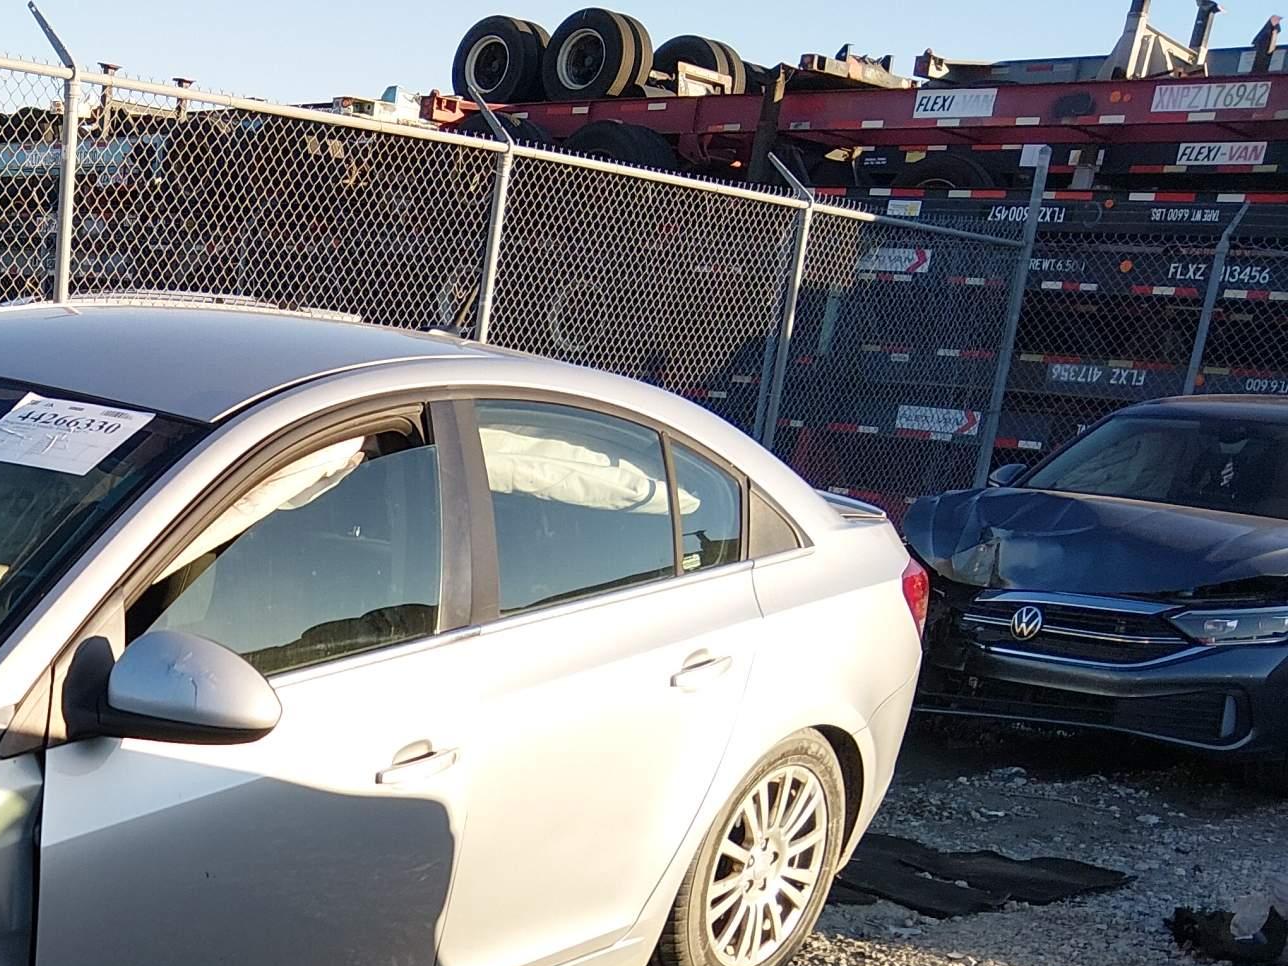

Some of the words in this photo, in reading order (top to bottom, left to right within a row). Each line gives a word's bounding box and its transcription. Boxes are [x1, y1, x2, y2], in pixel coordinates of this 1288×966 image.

[915, 95, 957, 113] FLEXI
[1178, 145, 1264, 162] FLEXI-VAN
[1168, 263, 1208, 280] FLXZ
[18, 410, 121, 434] 44266330
